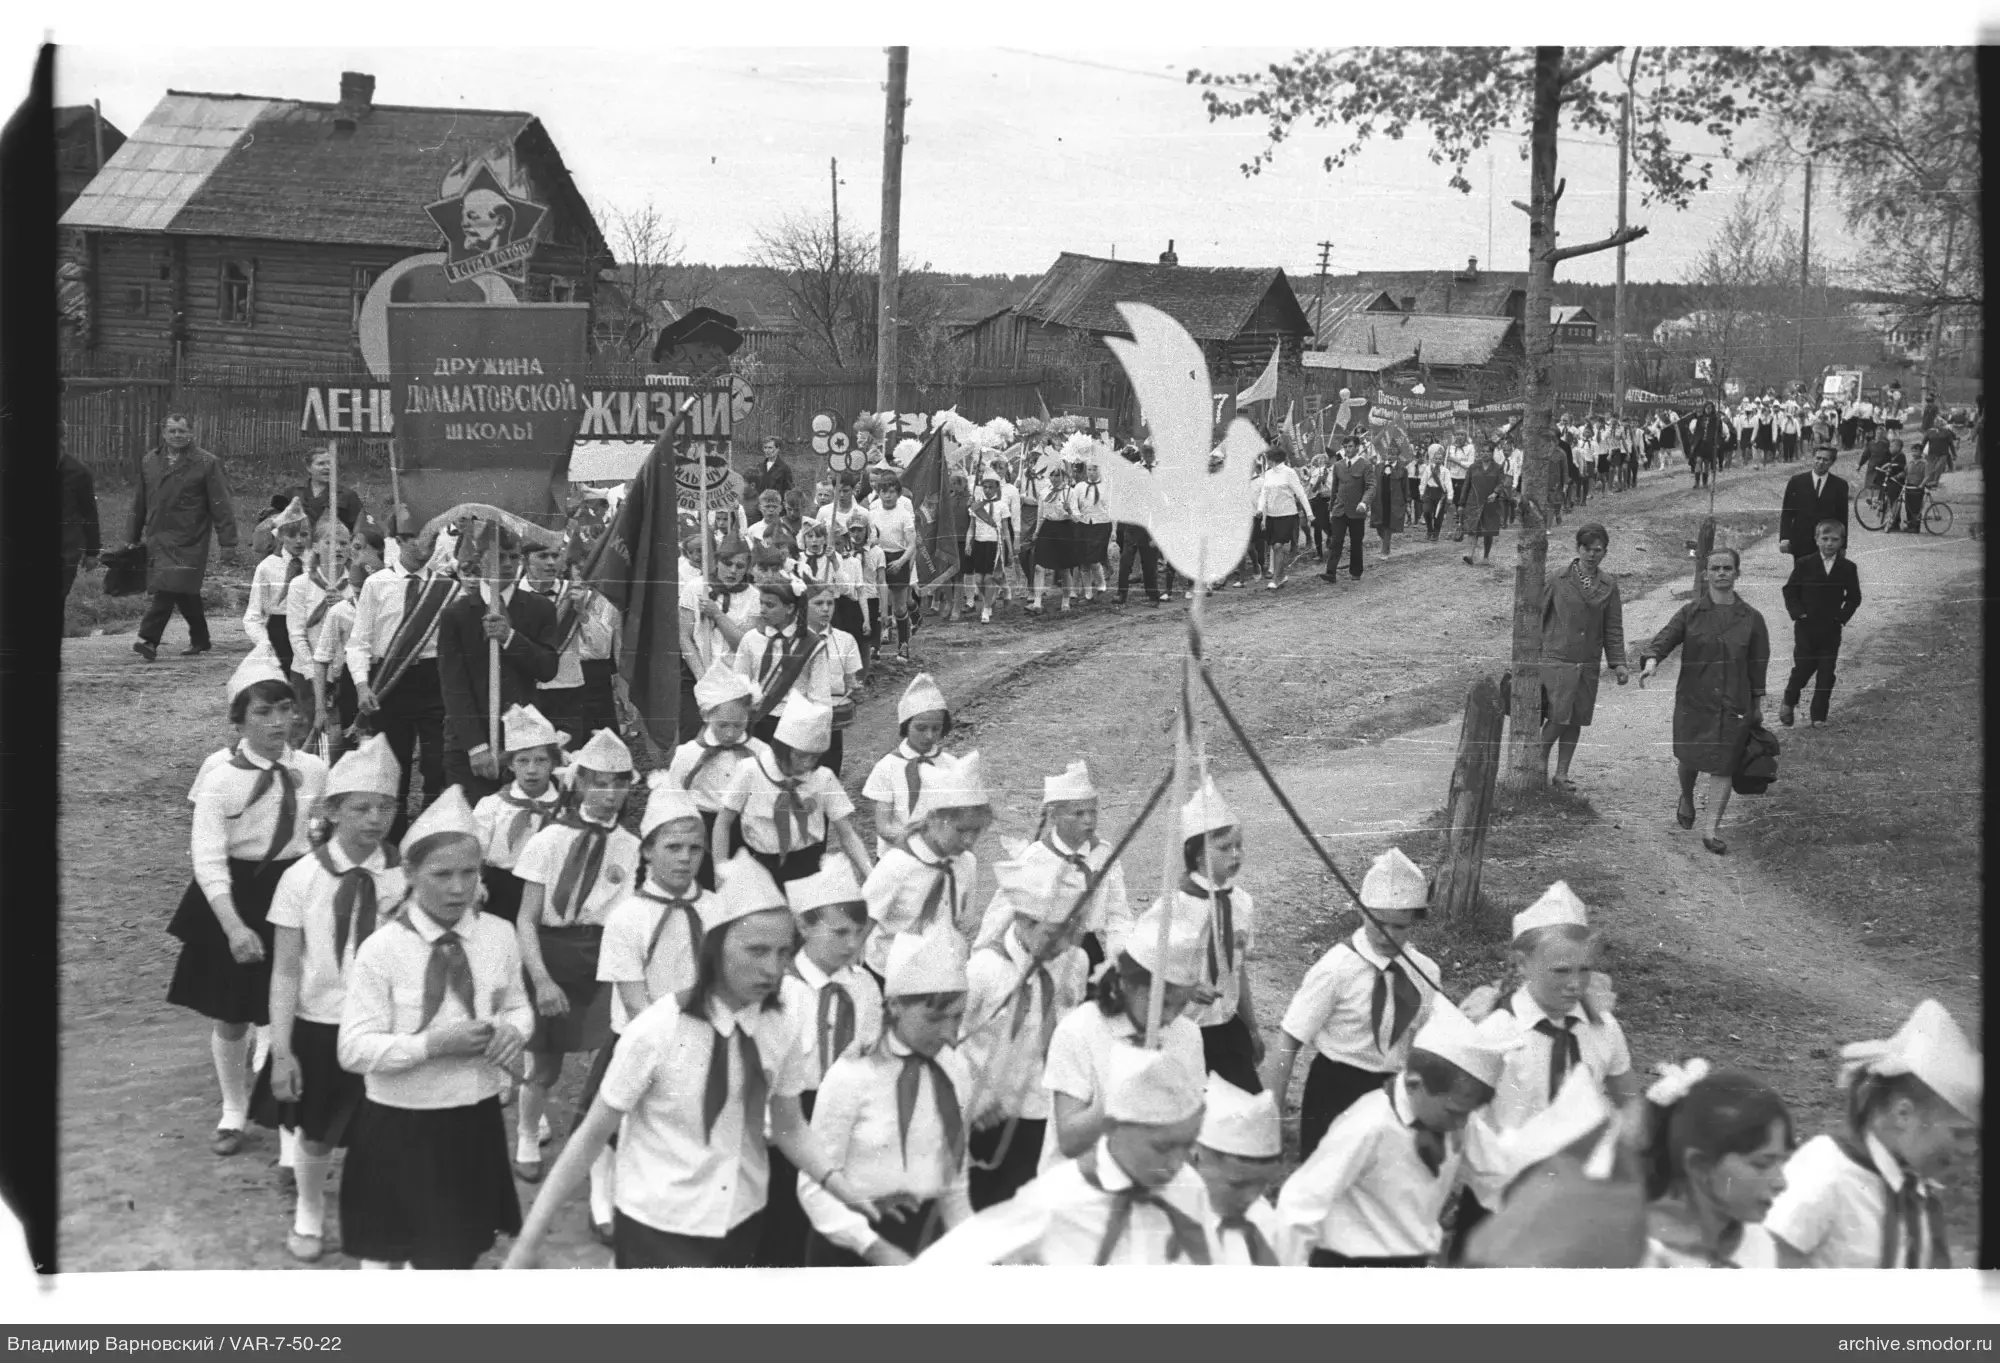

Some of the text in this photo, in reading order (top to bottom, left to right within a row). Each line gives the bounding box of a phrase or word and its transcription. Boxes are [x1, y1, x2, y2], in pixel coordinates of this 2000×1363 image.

[433, 357, 545, 376] ДРУЖИНА
[404, 378, 577, 414] ДОЛМАТОВСКОЙ
[578, 391, 731, 435] ЖИЗНИ
[445, 422, 533, 441] ШКОЛЫ
[675, 467, 721, 484] ИЛЬЧУ
[706, 490, 739, 510] ВЕТОВ
